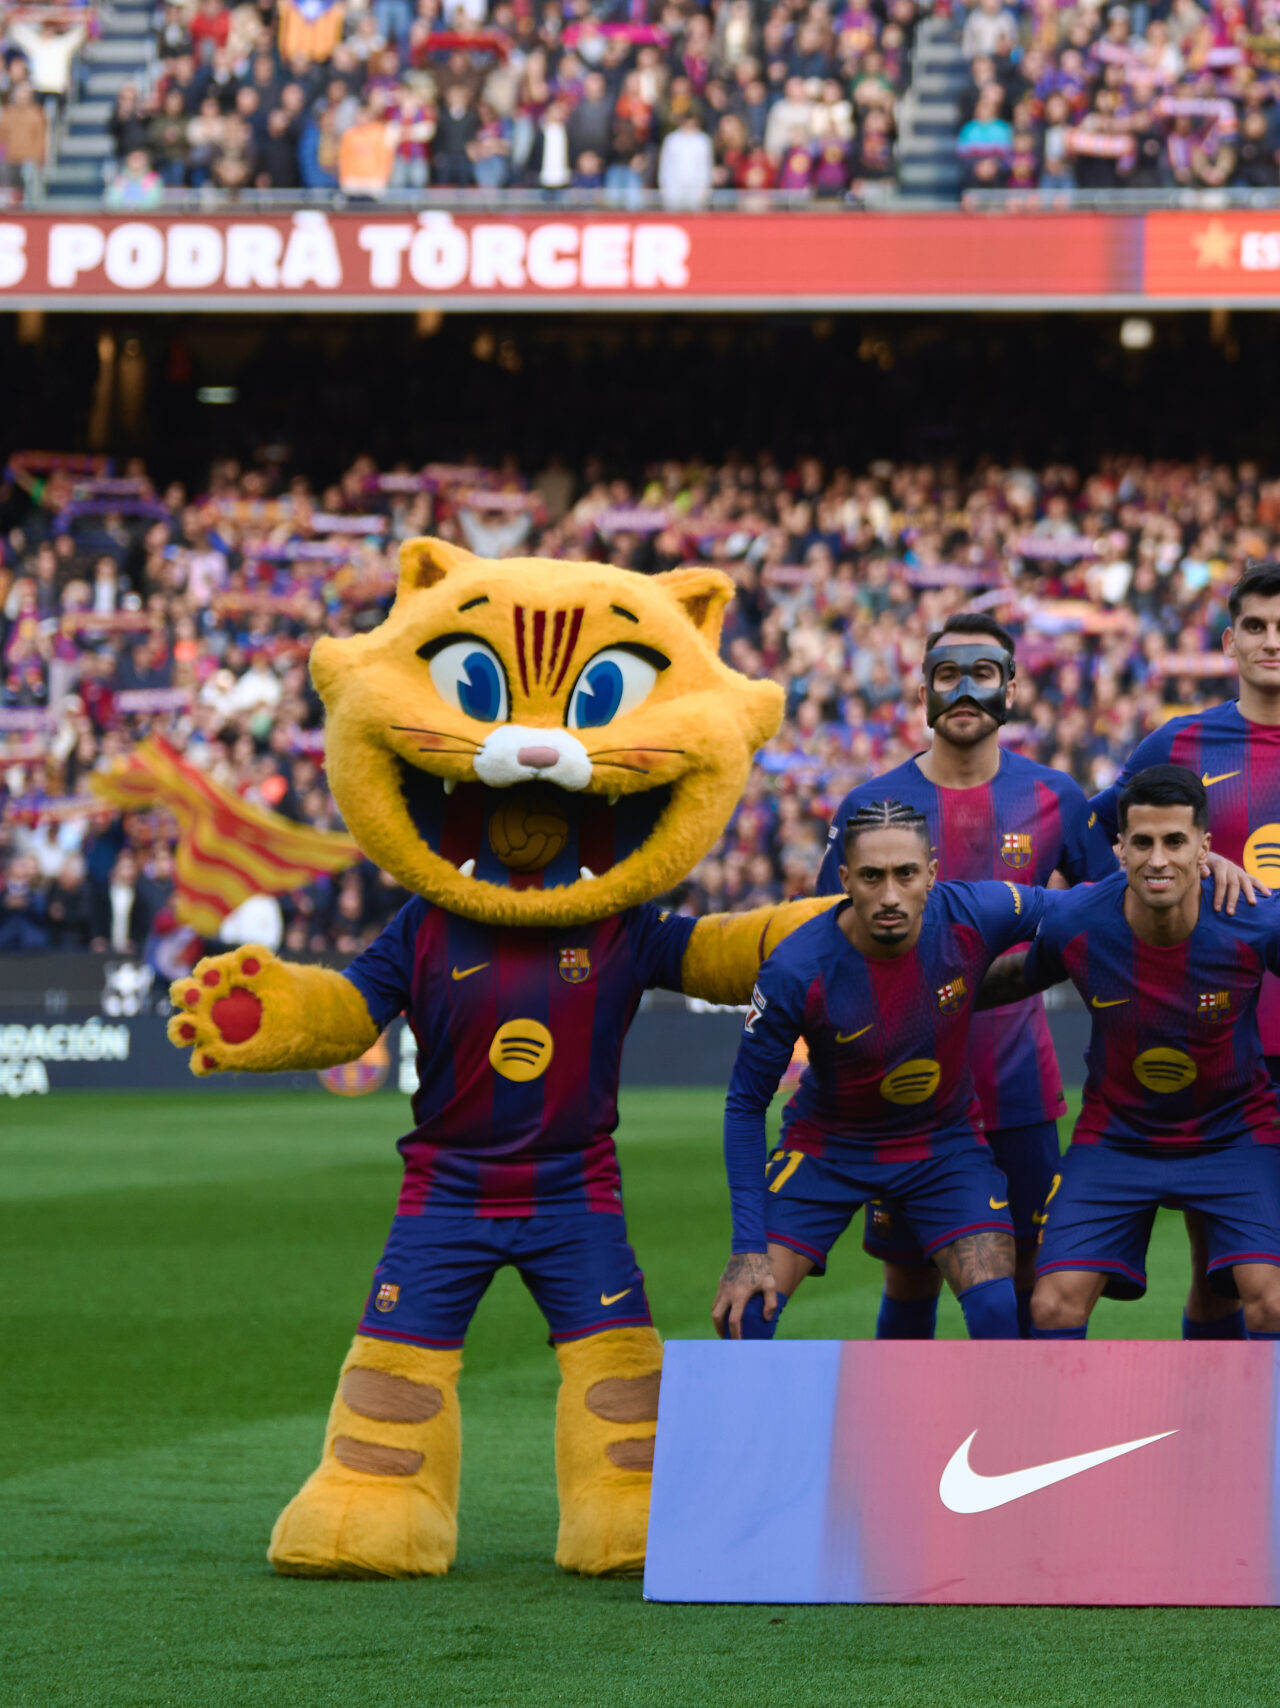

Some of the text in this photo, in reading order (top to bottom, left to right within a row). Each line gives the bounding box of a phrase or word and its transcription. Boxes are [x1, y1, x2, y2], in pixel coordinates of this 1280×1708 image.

[48, 210, 343, 289] PODRÀ
[358, 210, 690, 289] TÒRCER
[0, 1014, 130, 1061] DACIÓN
